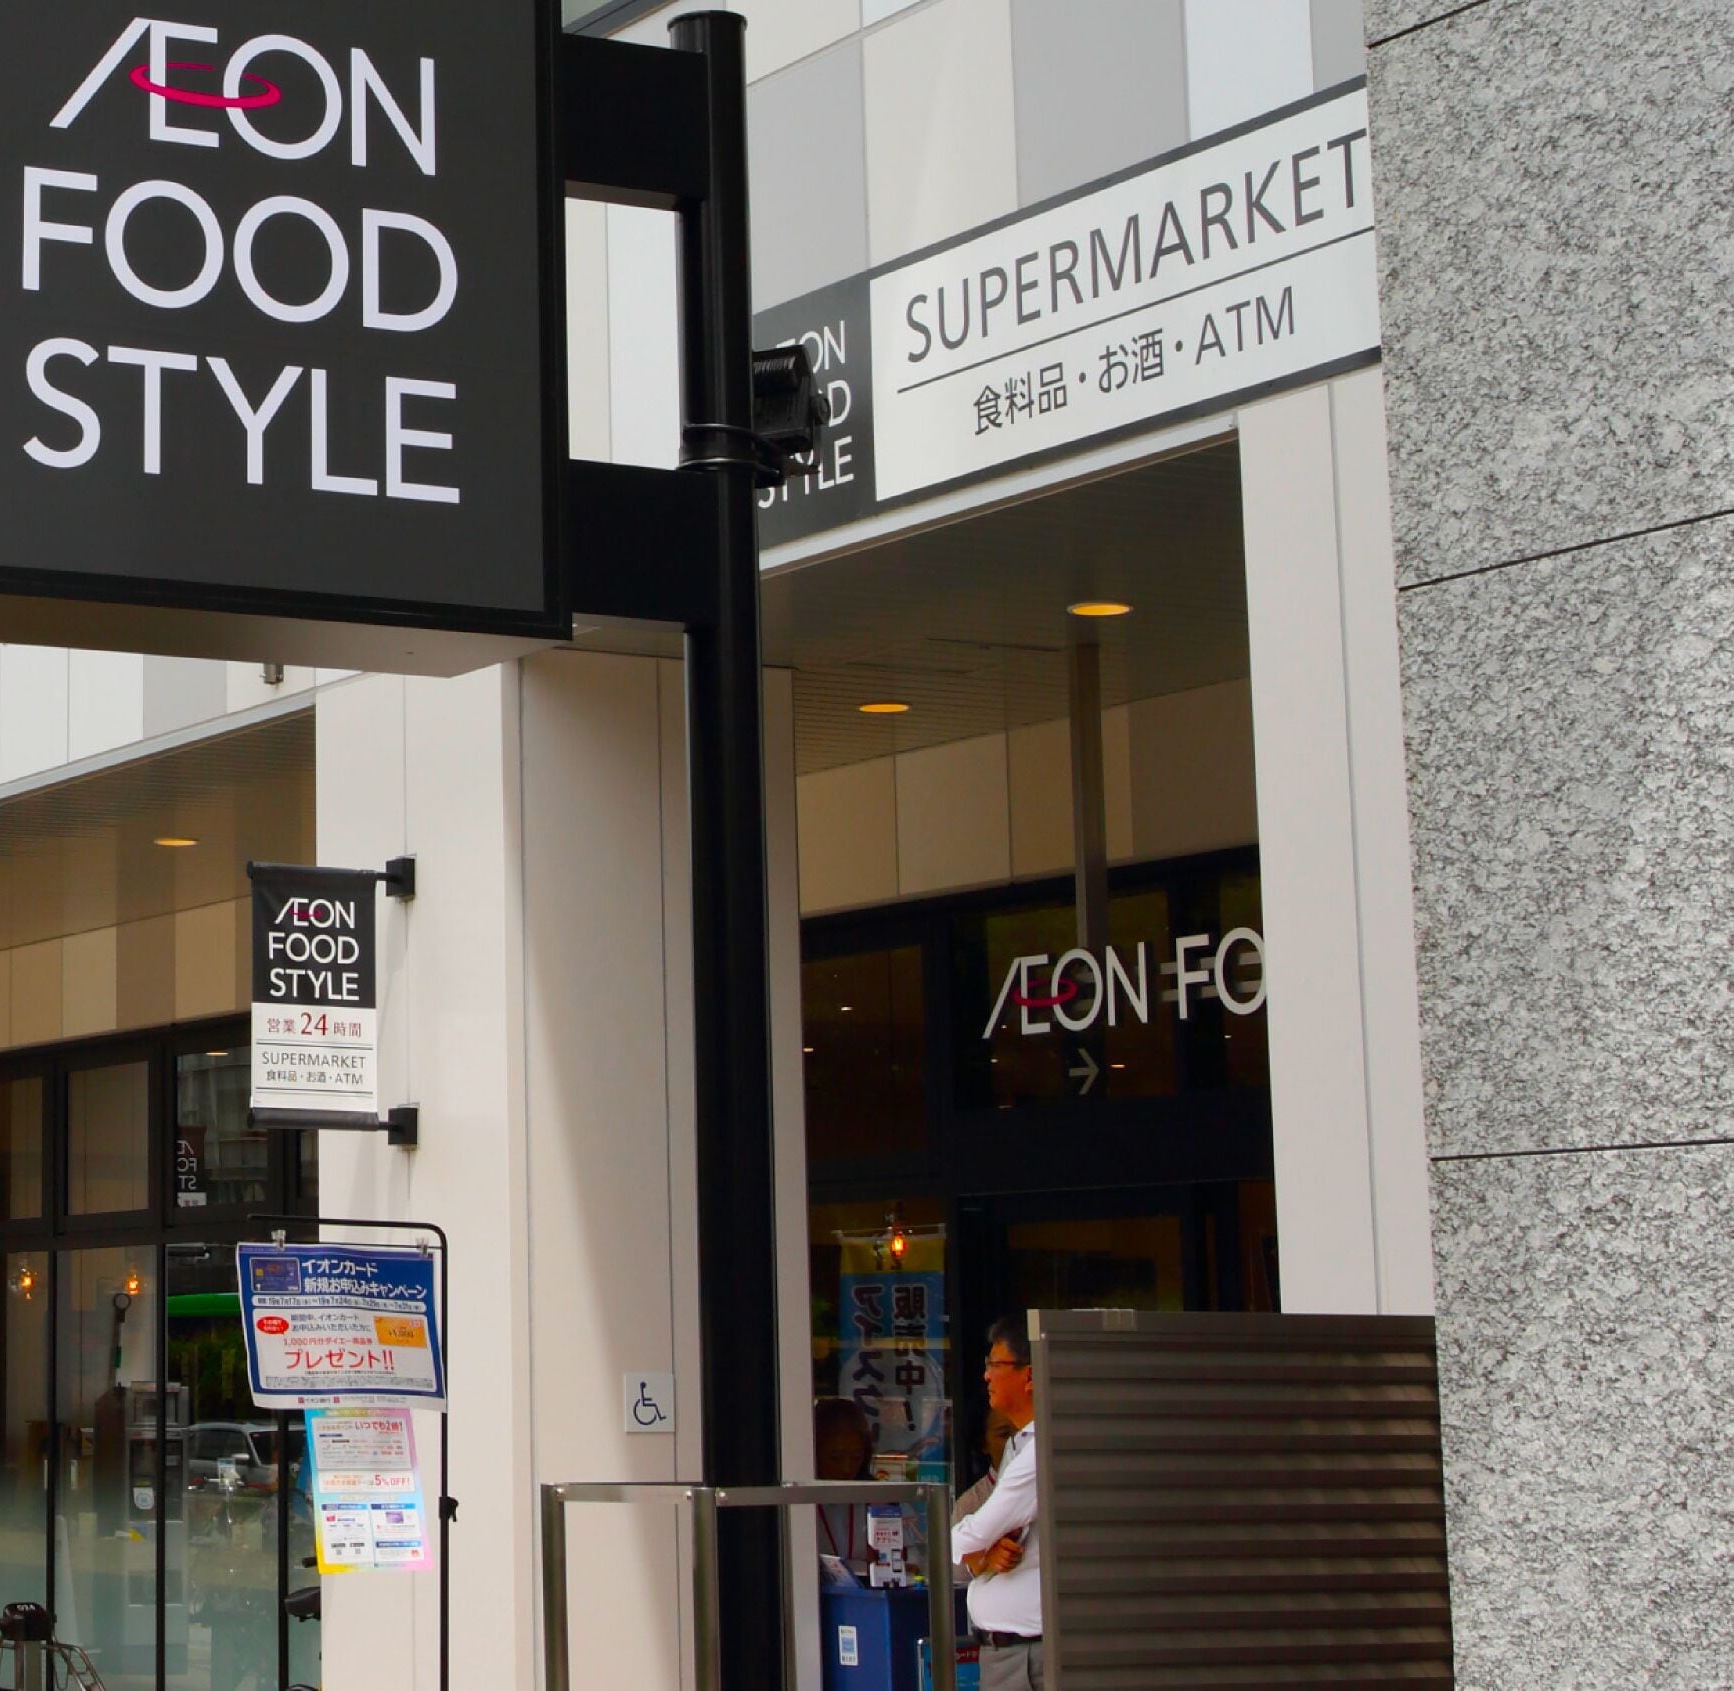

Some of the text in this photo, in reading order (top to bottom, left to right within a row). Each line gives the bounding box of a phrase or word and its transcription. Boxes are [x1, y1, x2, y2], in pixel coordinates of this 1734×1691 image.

[22, 165, 458, 332] FOOD
[906, 128, 1366, 363] SUPERMARKET
[22, 337, 460, 504] STYLE
[268, 932, 359, 964] FOOD
[270, 968, 359, 1000] STYLE
[262, 1051, 366, 1069] SUPERMARKET
[302, 1259, 378, 1277] イオンカード
